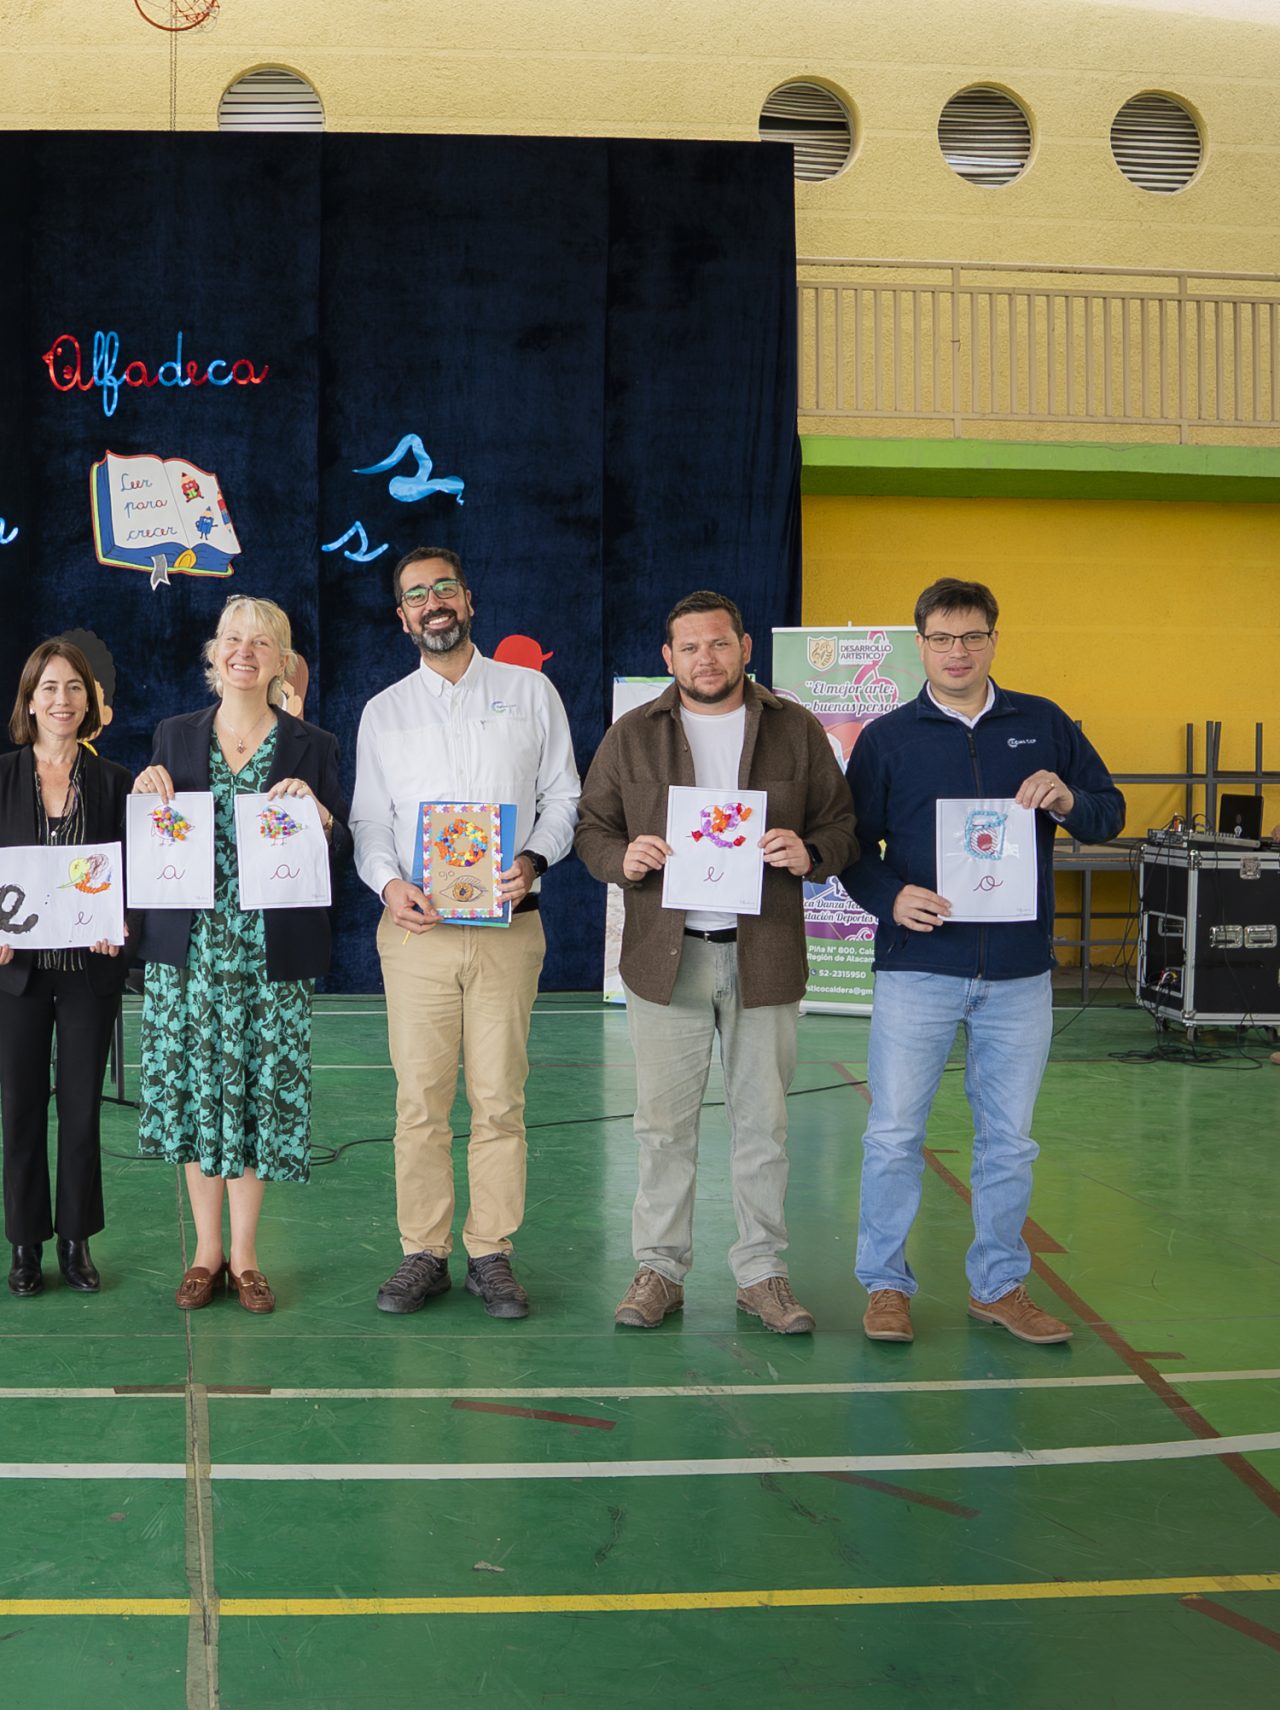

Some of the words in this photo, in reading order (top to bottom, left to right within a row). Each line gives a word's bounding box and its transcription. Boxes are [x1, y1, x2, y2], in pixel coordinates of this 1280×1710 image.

[42, 331, 269, 416] Alfadeca
[120, 473, 152, 492] Leer
[124, 498, 168, 518] para
[126, 525, 178, 542] crecer
[840, 644, 892, 652] DESARROLLO
[827, 683, 862, 697] mejor
[865, 683, 894, 694] arte:
[813, 701, 856, 712] buenas
[817, 900, 845, 908] Danza
[836, 913, 873, 925] Deportes
[809, 945, 826, 953] Piña
[807, 953, 833, 962] Región
[818, 969, 867, 979] 52-2315950
[806, 984, 874, 996] sticocaldera@gm
